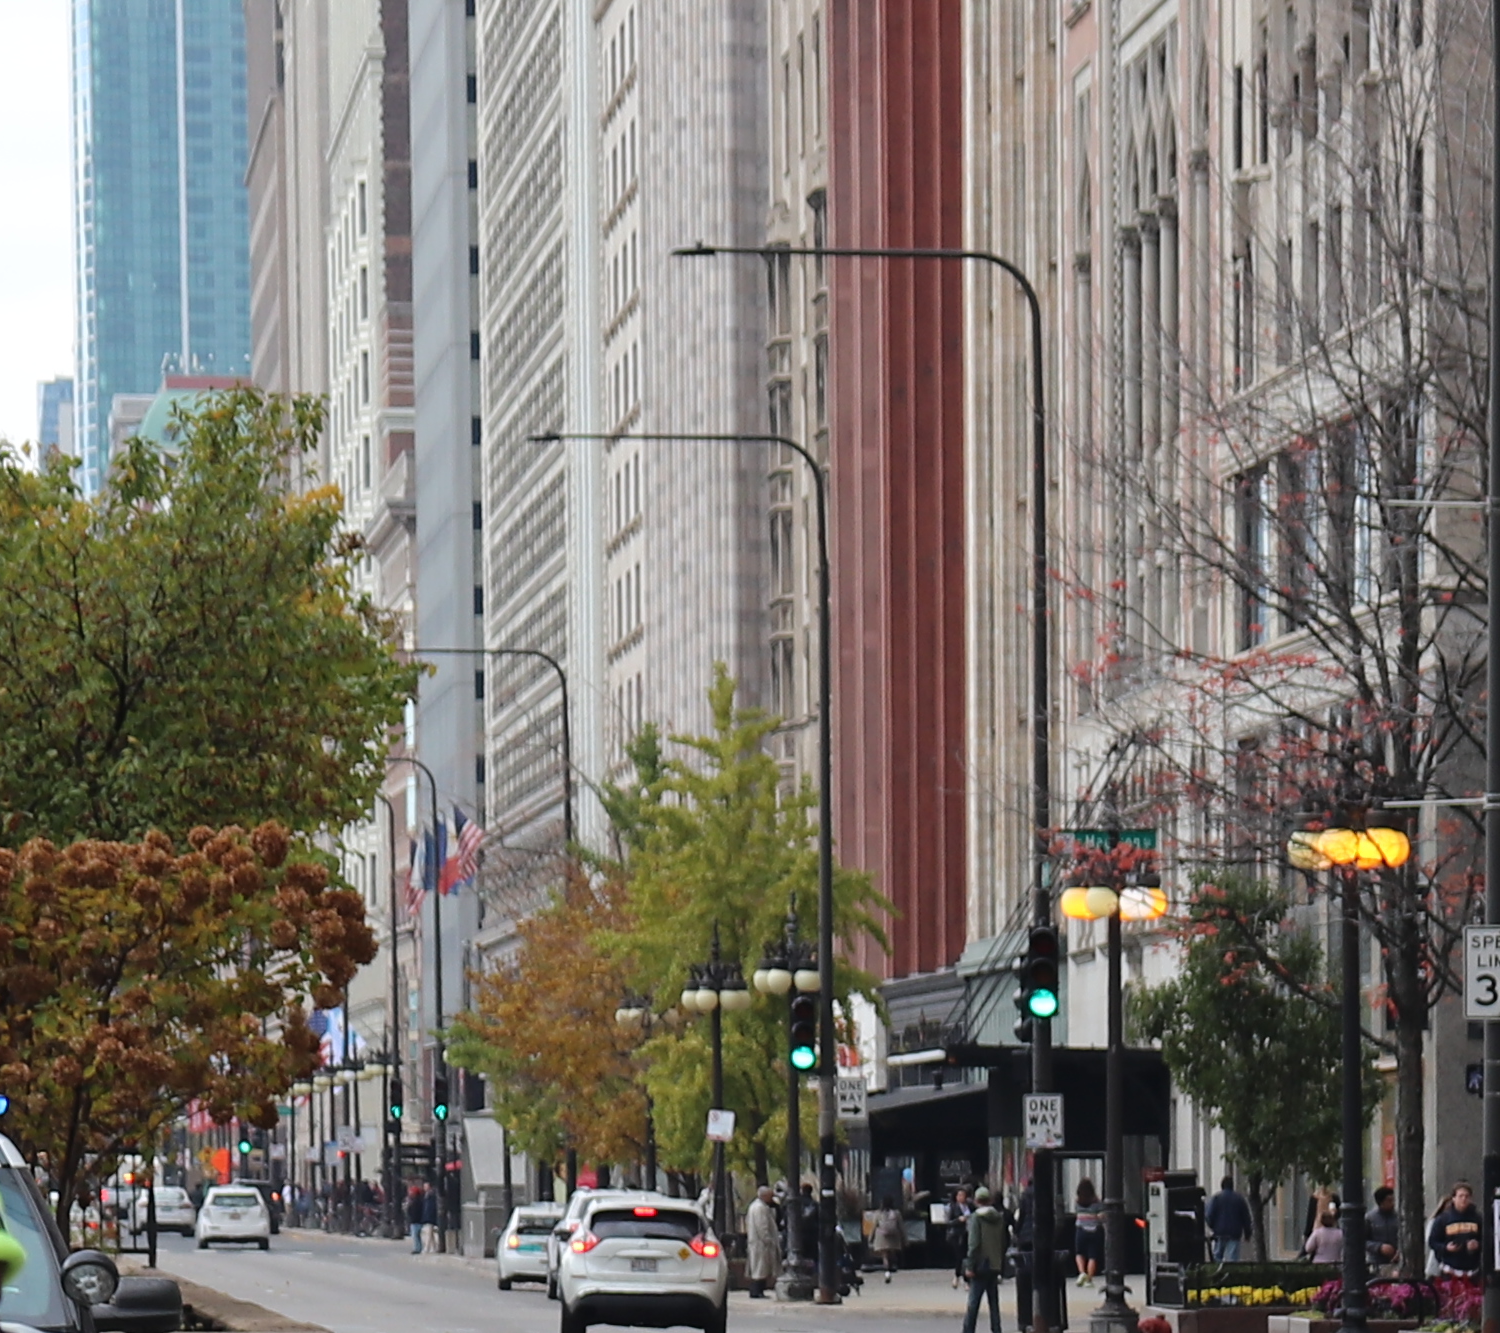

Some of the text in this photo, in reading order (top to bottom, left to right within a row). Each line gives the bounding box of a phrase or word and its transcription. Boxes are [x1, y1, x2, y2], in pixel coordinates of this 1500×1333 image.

[839, 1077, 862, 1091] ONE
[839, 1092, 863, 1102] WAY
[1028, 1099, 1058, 1112] ONE
[1028, 1114, 1059, 1126] WAY
